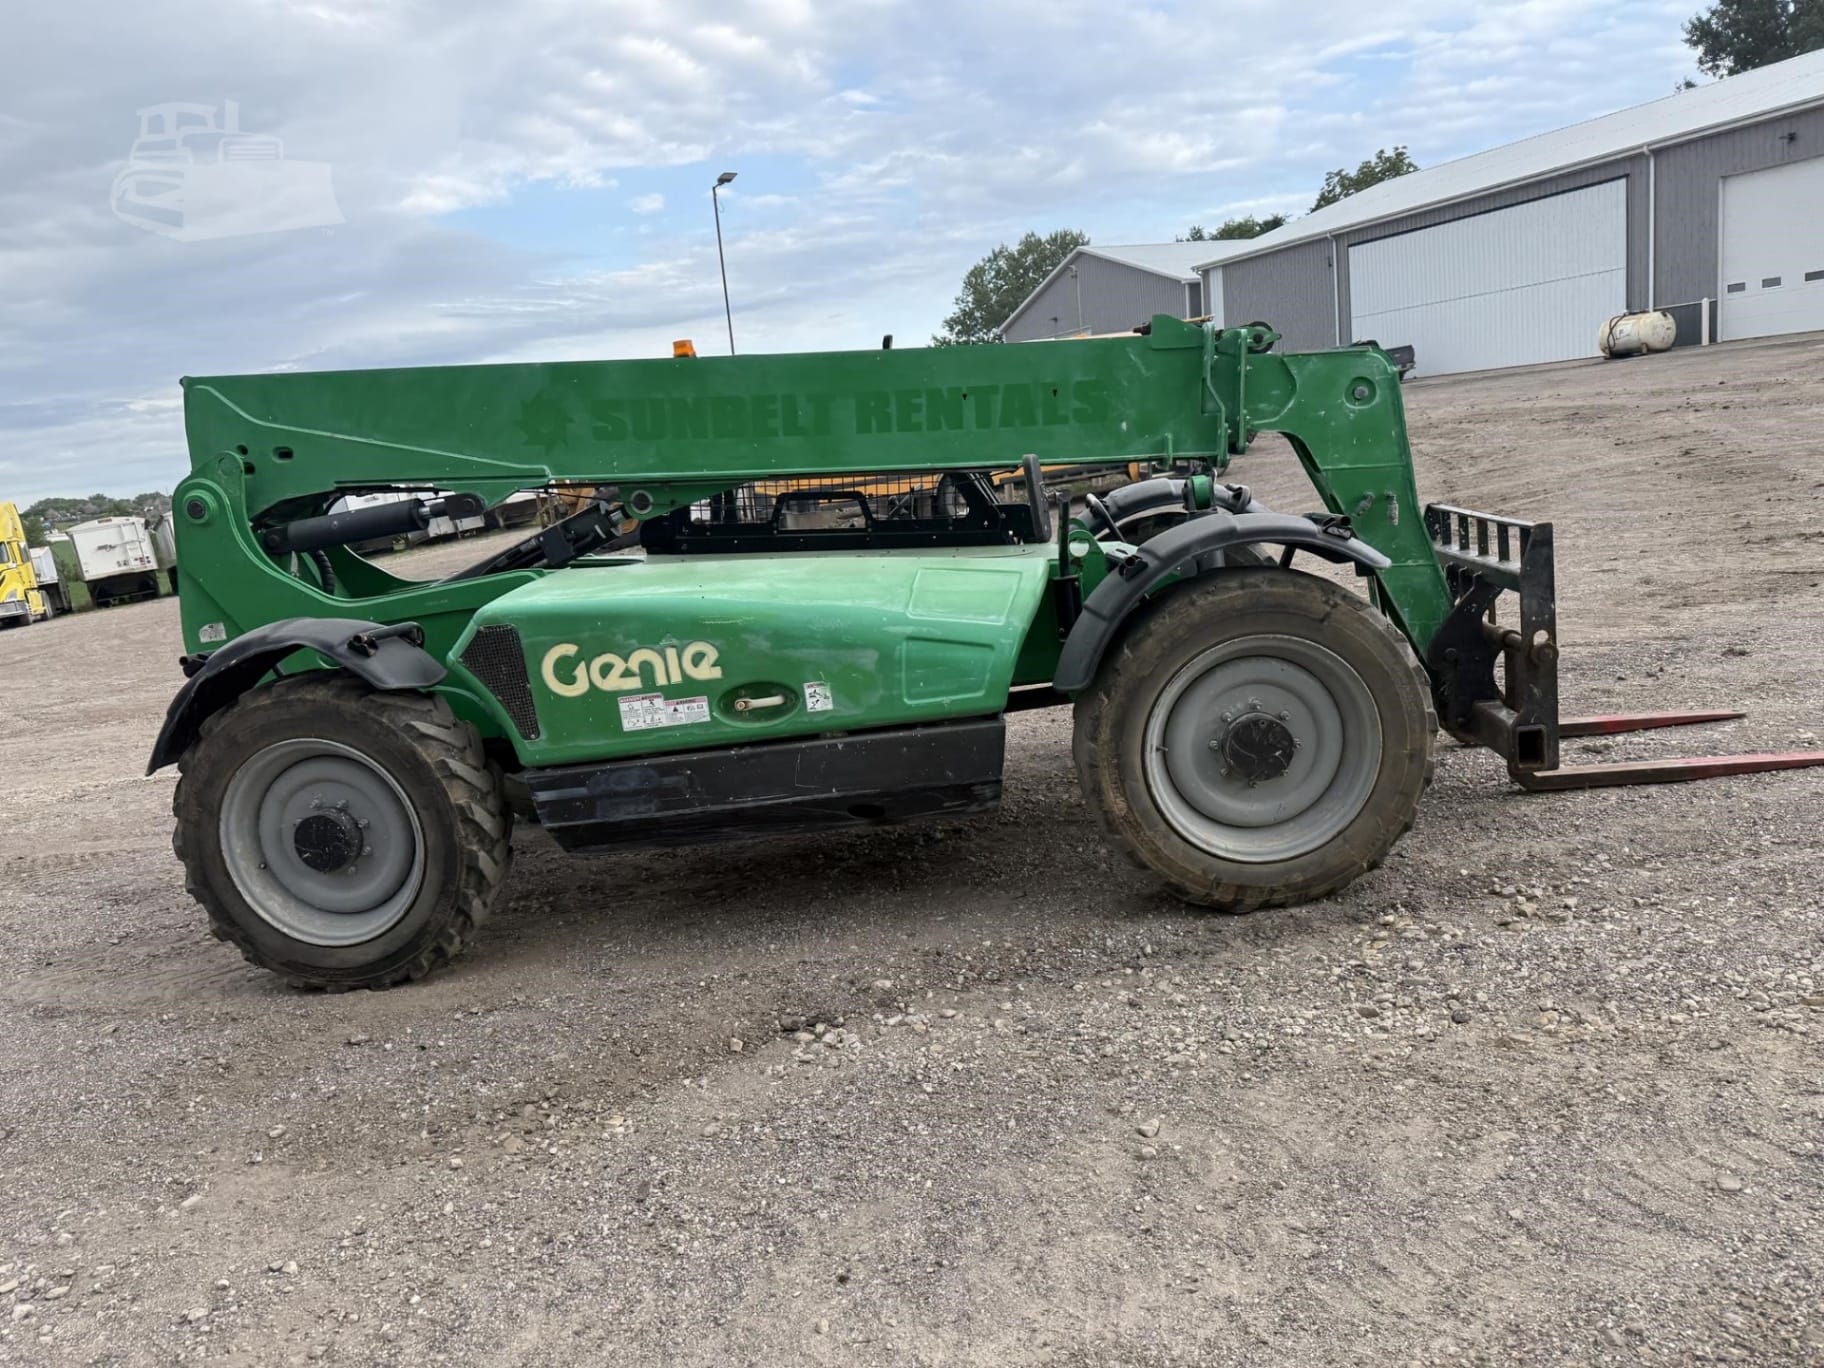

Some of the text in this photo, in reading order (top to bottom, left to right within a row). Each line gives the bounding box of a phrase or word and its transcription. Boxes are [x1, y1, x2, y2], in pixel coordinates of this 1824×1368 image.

[591, 379, 1109, 441] SUNBELT RENTALS
[541, 641, 722, 697] Genie
